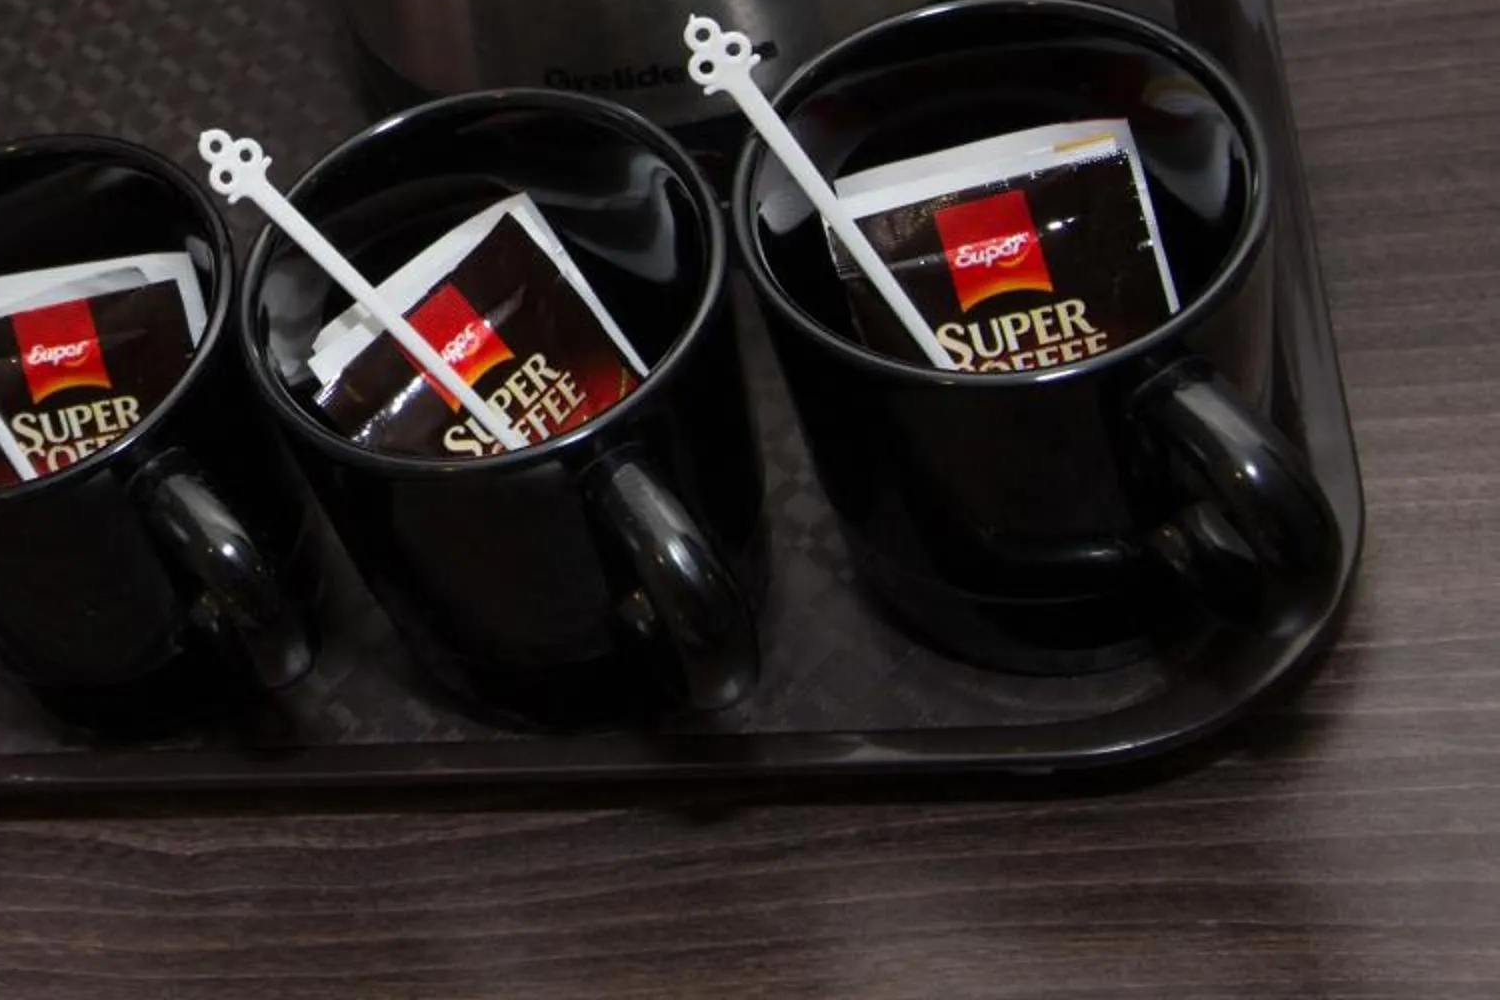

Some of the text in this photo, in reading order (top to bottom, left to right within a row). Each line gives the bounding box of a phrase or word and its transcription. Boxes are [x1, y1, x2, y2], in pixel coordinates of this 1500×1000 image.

[955, 232, 1030, 268] Super
[28, 340, 90, 367] Super
[937, 299, 1097, 366] SUPER
[11, 395, 141, 452] SUPER
